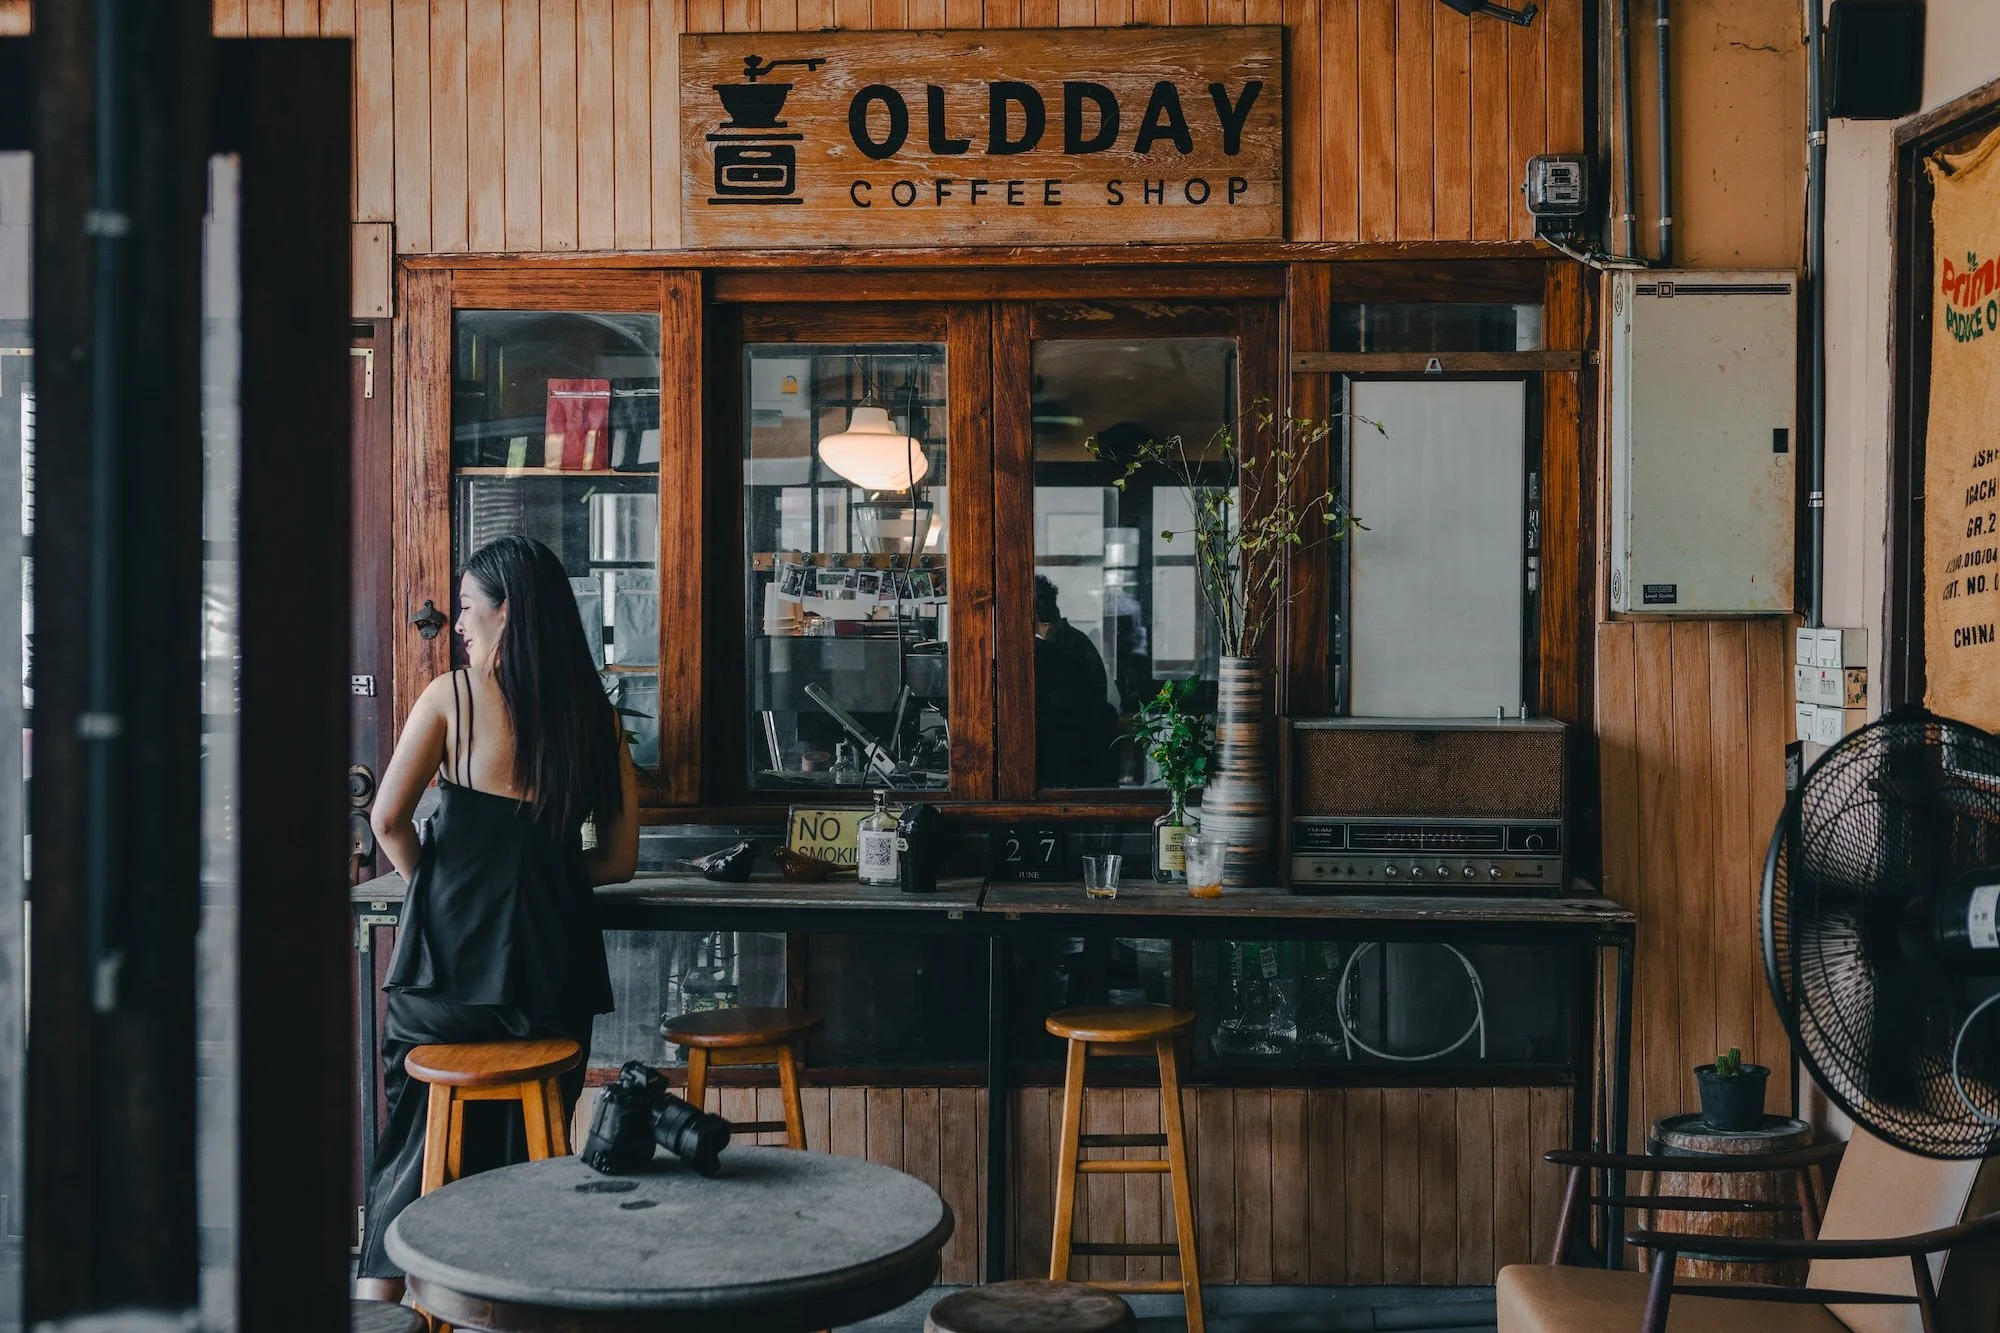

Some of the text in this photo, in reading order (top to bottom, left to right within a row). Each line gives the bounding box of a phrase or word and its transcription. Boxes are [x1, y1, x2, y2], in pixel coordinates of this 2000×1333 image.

[848, 80, 1263, 160] OLDDAY
[850, 176, 1250, 208] COFFEE SHOP
[1942, 254, 2000, 308] Prim
[1967, 574, 1989, 596] NO.
[1954, 623, 1995, 648] CHINA
[799, 817, 841, 842] NO
[1018, 871, 1040, 879] JUNE
